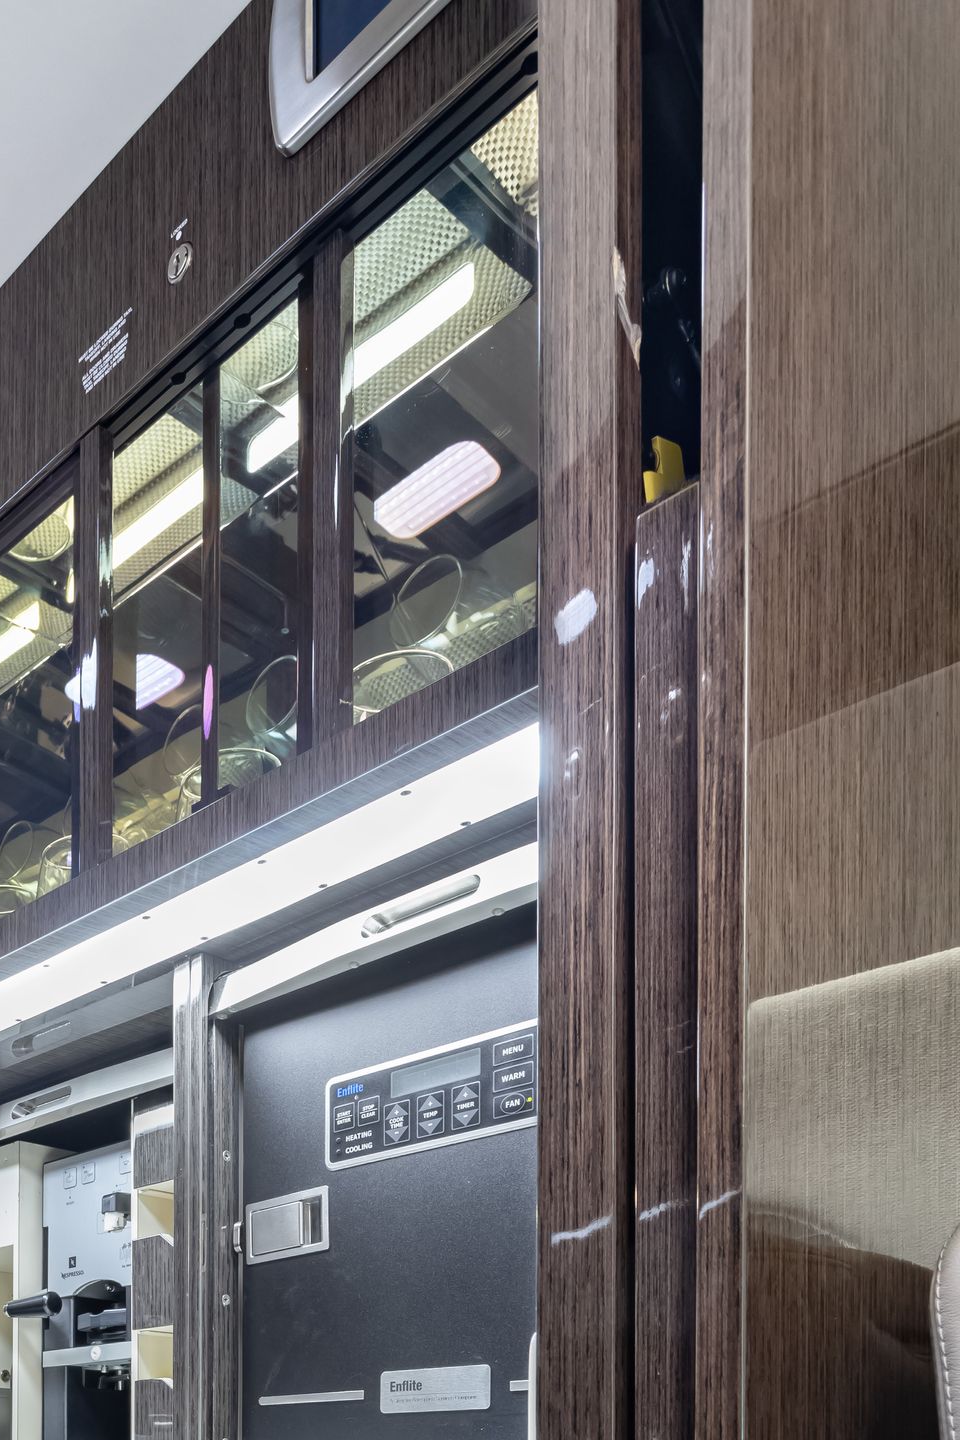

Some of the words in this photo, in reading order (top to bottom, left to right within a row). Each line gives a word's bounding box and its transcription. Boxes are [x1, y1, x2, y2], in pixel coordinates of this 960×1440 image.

[502, 1044, 524, 1056] MENU
[501, 1070, 526, 1083] WARM
[336, 1083, 364, 1098] Enflite
[456, 1101, 475, 1110] TIMER
[505, 1098, 521, 1109] FAN
[388, 1116, 404, 1124] COOK
[422, 1110, 439, 1118] TEMP
[345, 1130, 373, 1142] HEATING
[345, 1142, 373, 1154] COOLING
[390, 1380, 423, 1392] Enflite
